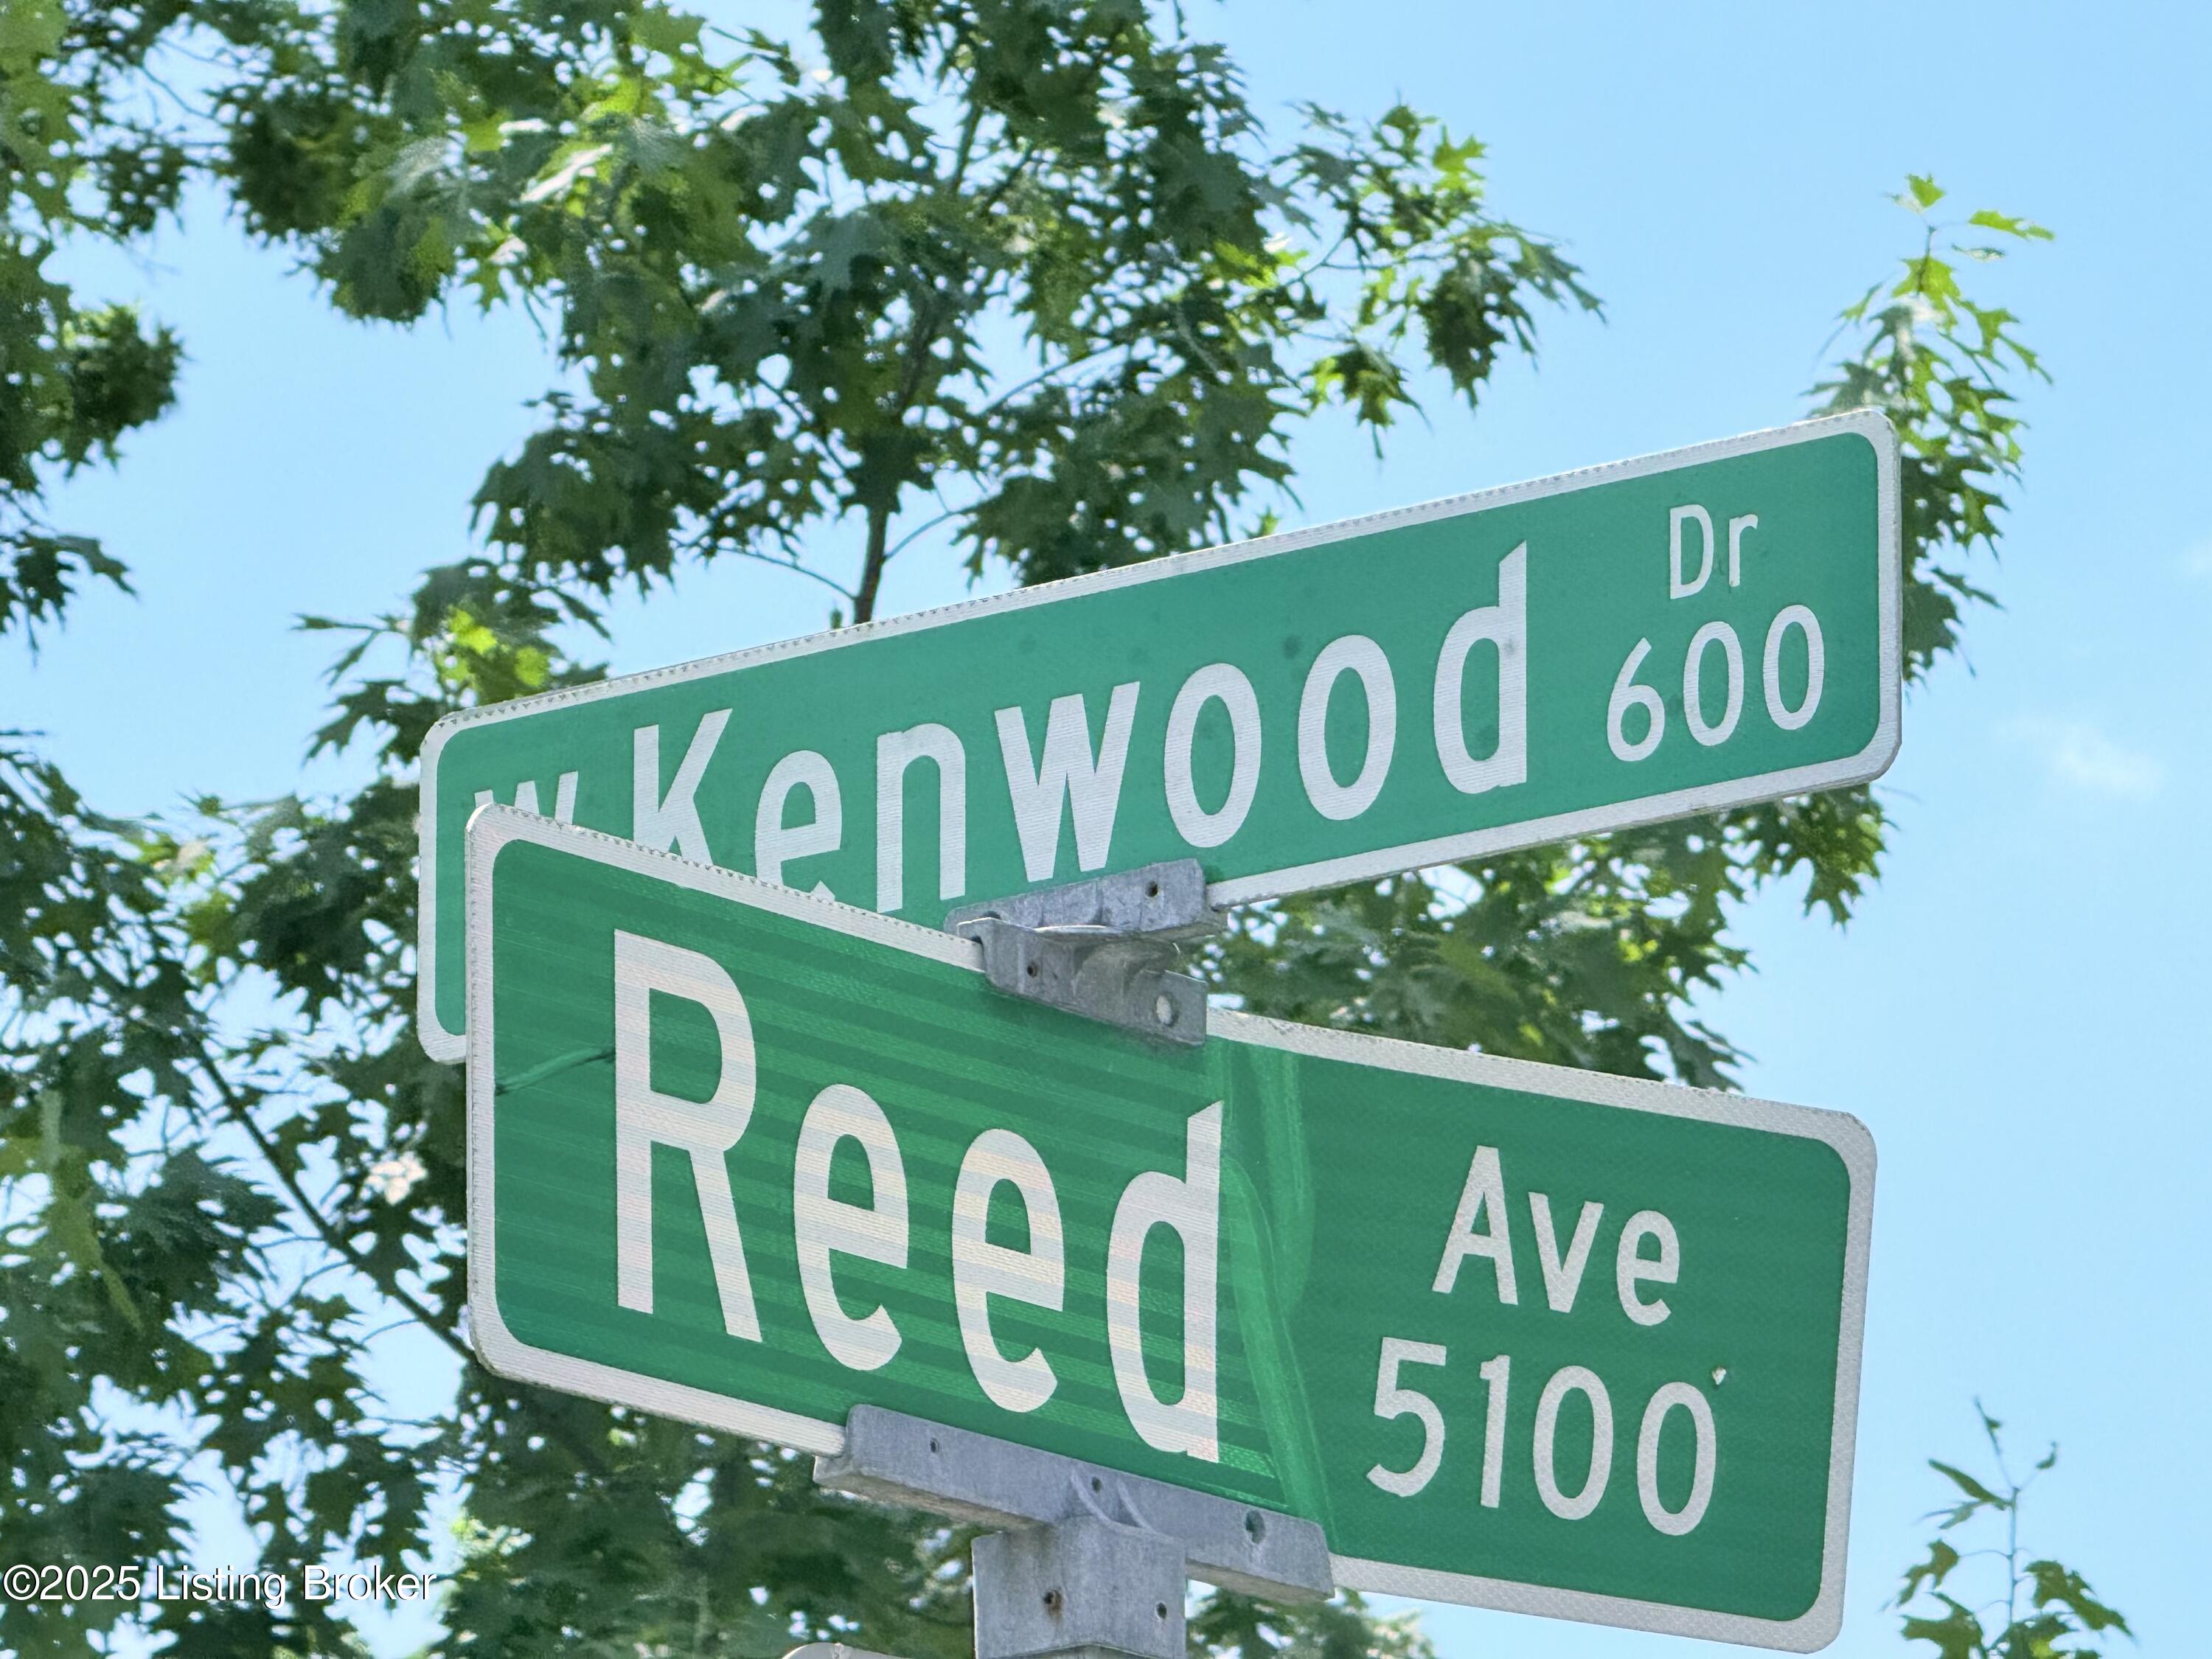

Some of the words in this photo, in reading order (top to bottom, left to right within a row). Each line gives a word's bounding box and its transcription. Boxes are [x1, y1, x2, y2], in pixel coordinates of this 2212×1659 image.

[1669, 504, 1759, 599] Dr
[633, 539, 1528, 914] Kenwood
[1607, 604, 1825, 762] 600
[613, 928, 1223, 1464] Reed
[1431, 1144, 1680, 1326] Ave
[1366, 1336, 1717, 1537] 5100
